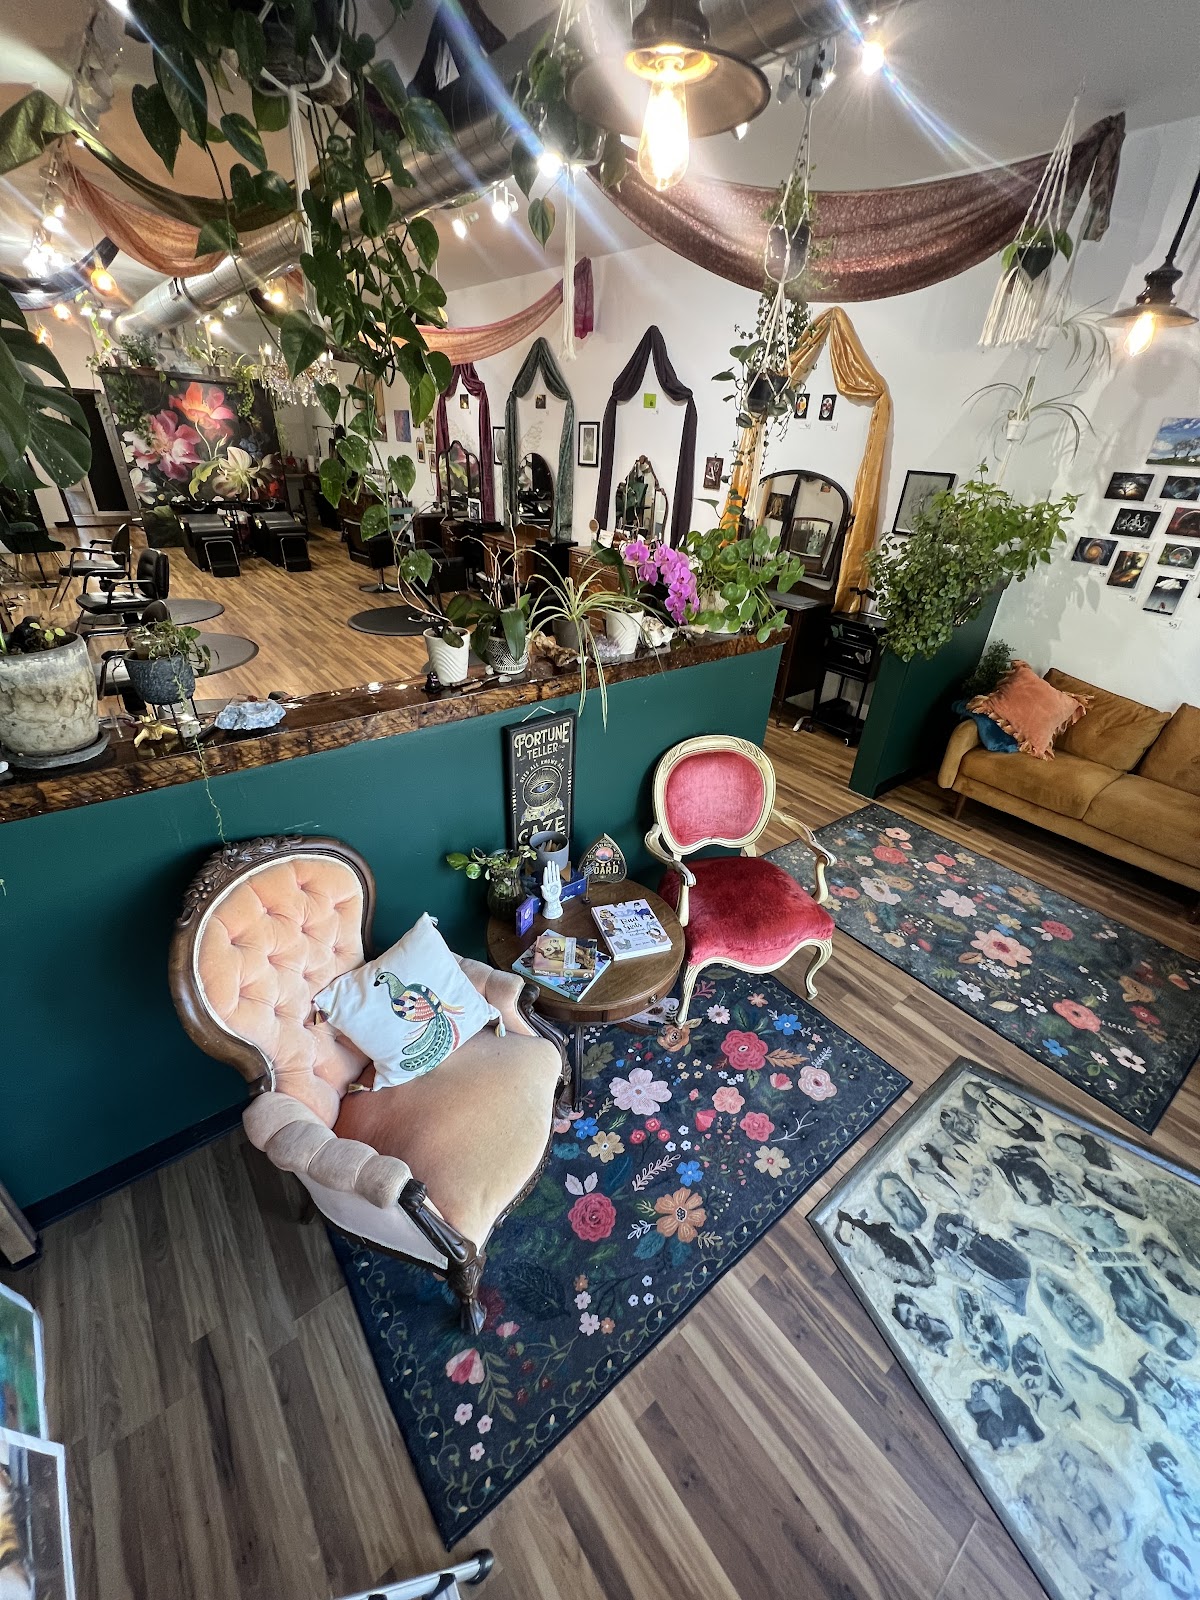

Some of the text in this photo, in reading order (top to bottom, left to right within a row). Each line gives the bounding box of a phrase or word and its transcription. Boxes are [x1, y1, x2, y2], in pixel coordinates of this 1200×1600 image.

[514, 722, 570, 757] FORTUNE
[527, 742, 558, 760] TELLER
[530, 762, 539, 771] ALL
[592, 864, 619, 875] OARD
